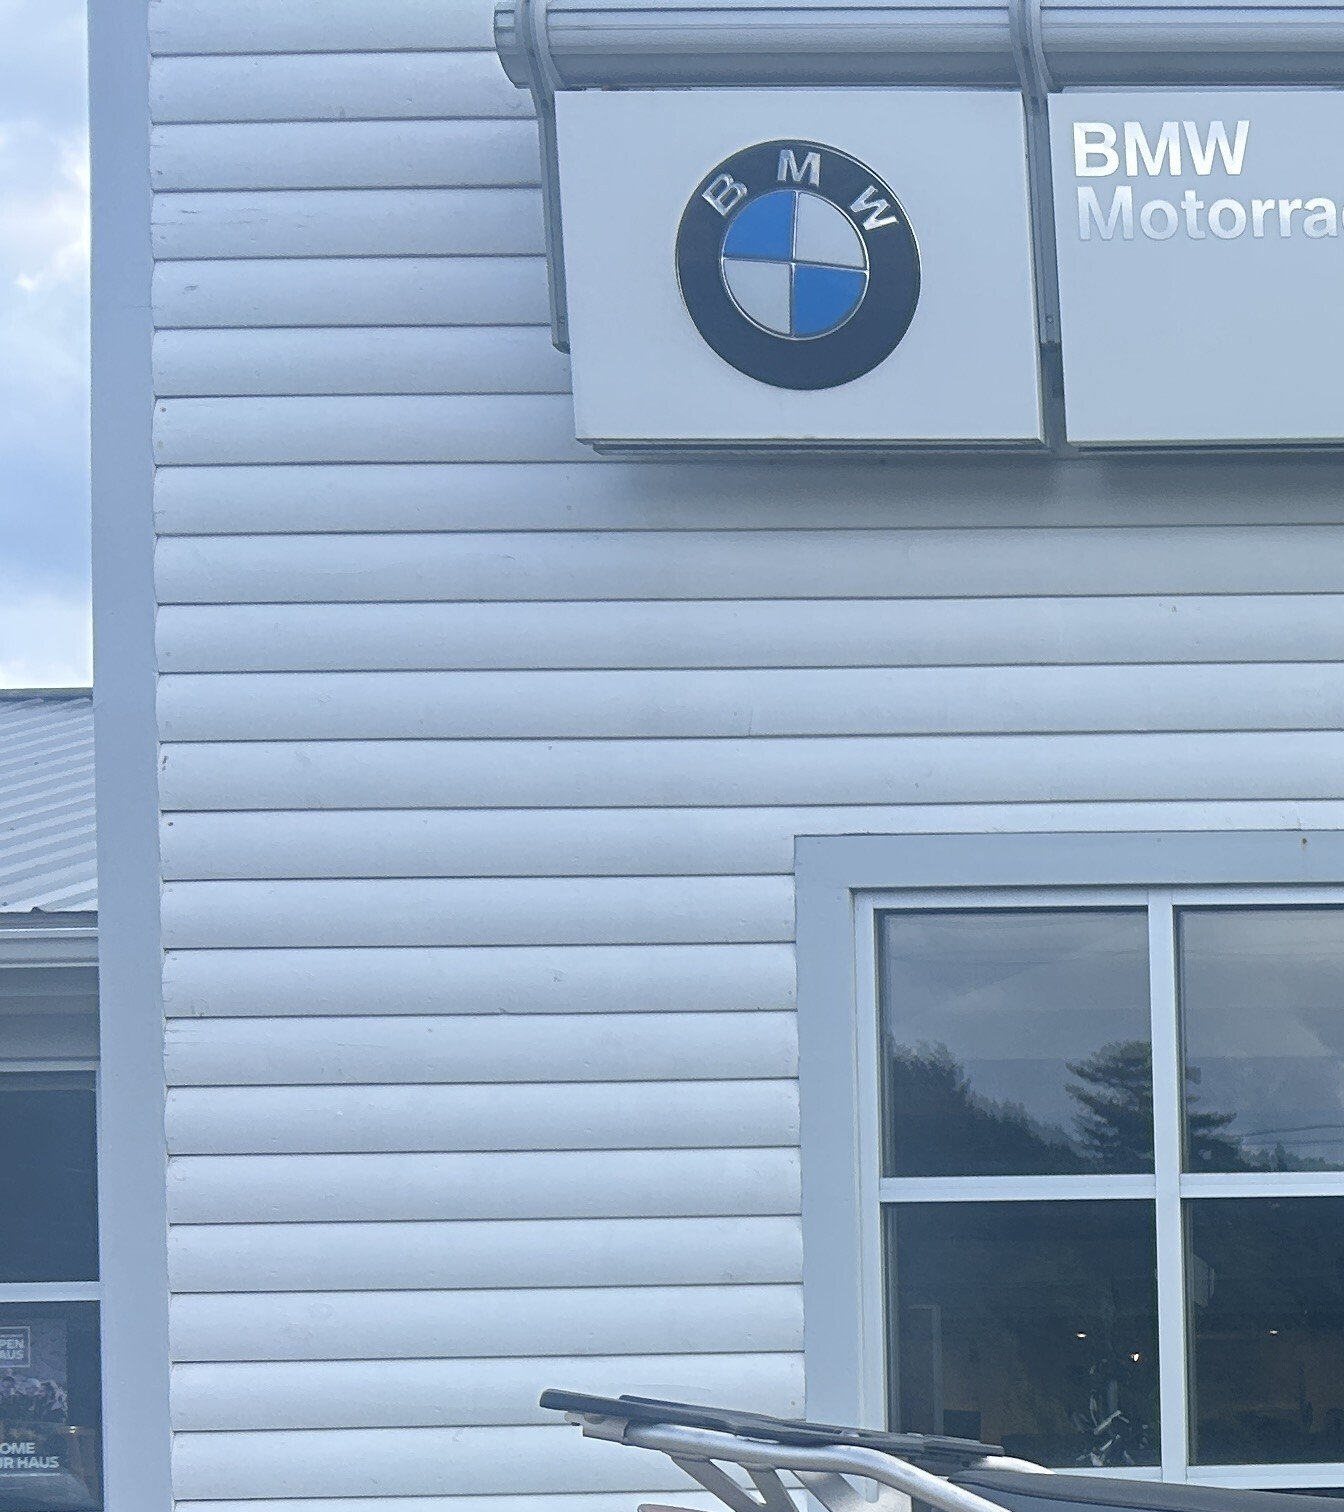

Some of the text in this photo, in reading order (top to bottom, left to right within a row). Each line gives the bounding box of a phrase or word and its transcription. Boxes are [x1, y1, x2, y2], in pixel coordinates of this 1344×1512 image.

[1073, 120, 1250, 178] BMW
[702, 149, 899, 236] BMW
[18, 1456, 60, 1469] HAUS
